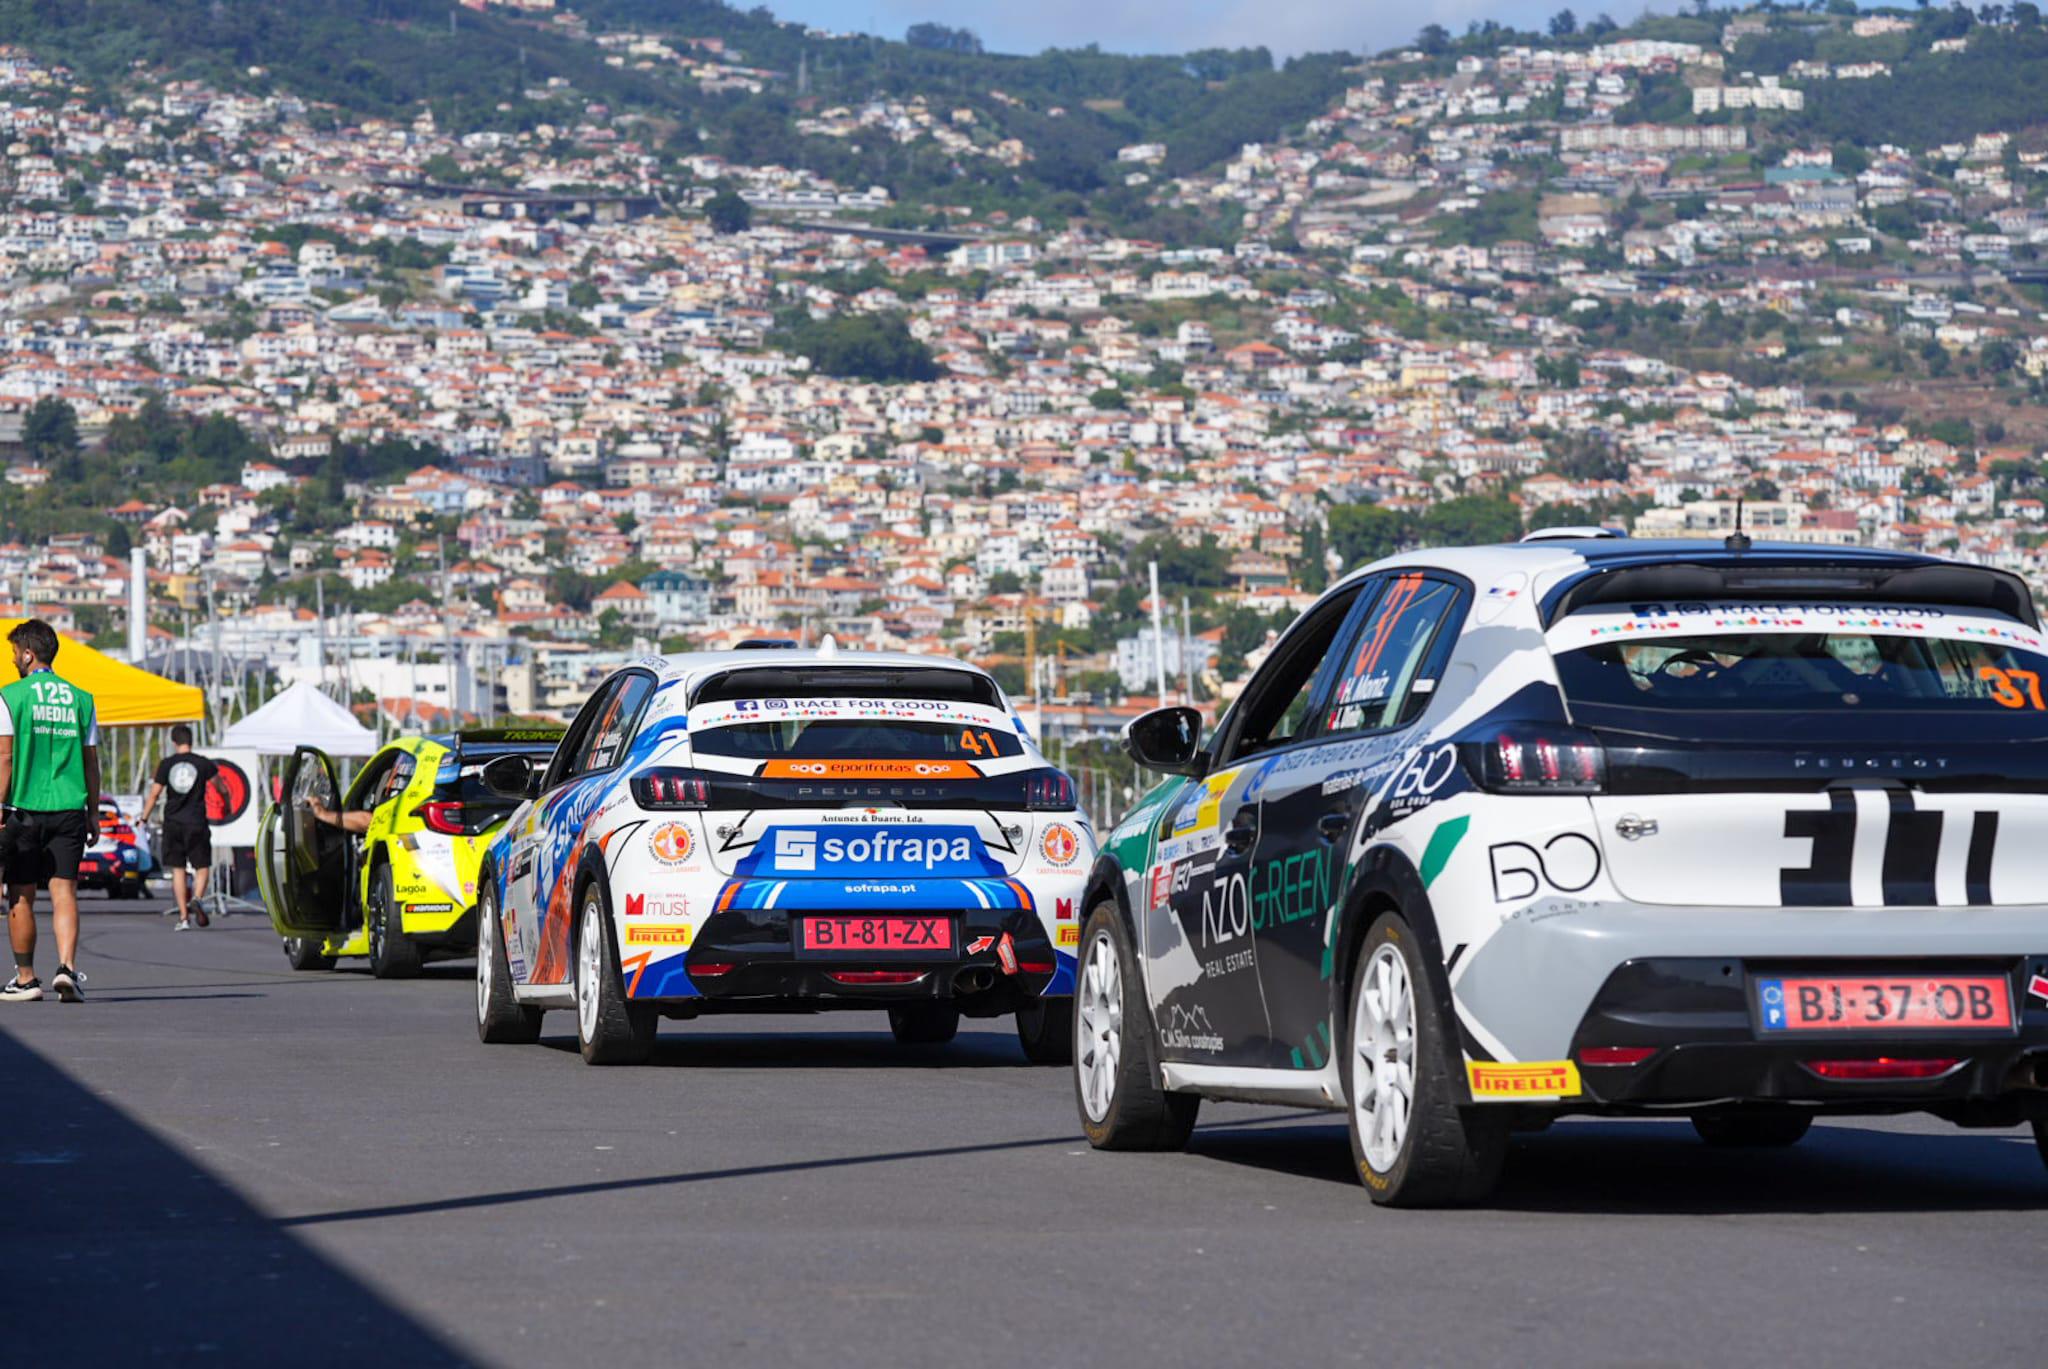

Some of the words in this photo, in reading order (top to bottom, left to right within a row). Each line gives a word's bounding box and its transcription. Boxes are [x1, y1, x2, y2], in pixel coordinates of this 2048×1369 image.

[1719, 603, 1796, 615] RACE
[1800, 603, 1854, 616] FOR
[1862, 605, 1945, 618] GOOD
[1354, 572, 1424, 677] 37
[31, 681, 74, 705] 125
[1979, 666, 2047, 711] 37
[33, 704, 77, 723] MEDIA
[794, 700, 843, 708] RACE
[848, 700, 886, 708] FOR
[892, 700, 949, 710] GOOD
[960, 729, 999, 757] 41
[1794, 757, 1949, 769] PEUGEOT
[798, 786, 946, 796] PEUGEOT
[823, 830, 972, 870] sofrapa
[844, 884, 917, 894] sofrapa.pt
[646, 899, 691, 916] must
[629, 927, 685, 942] PIRELLI
[815, 920, 938, 945] BT-81-ZX
[1205, 959, 1227, 979] REAL
[1225, 949, 1255, 973] ESTATE
[1769, 1008, 1781, 1025] P
[1473, 1068, 1567, 1091] PIRELLI
